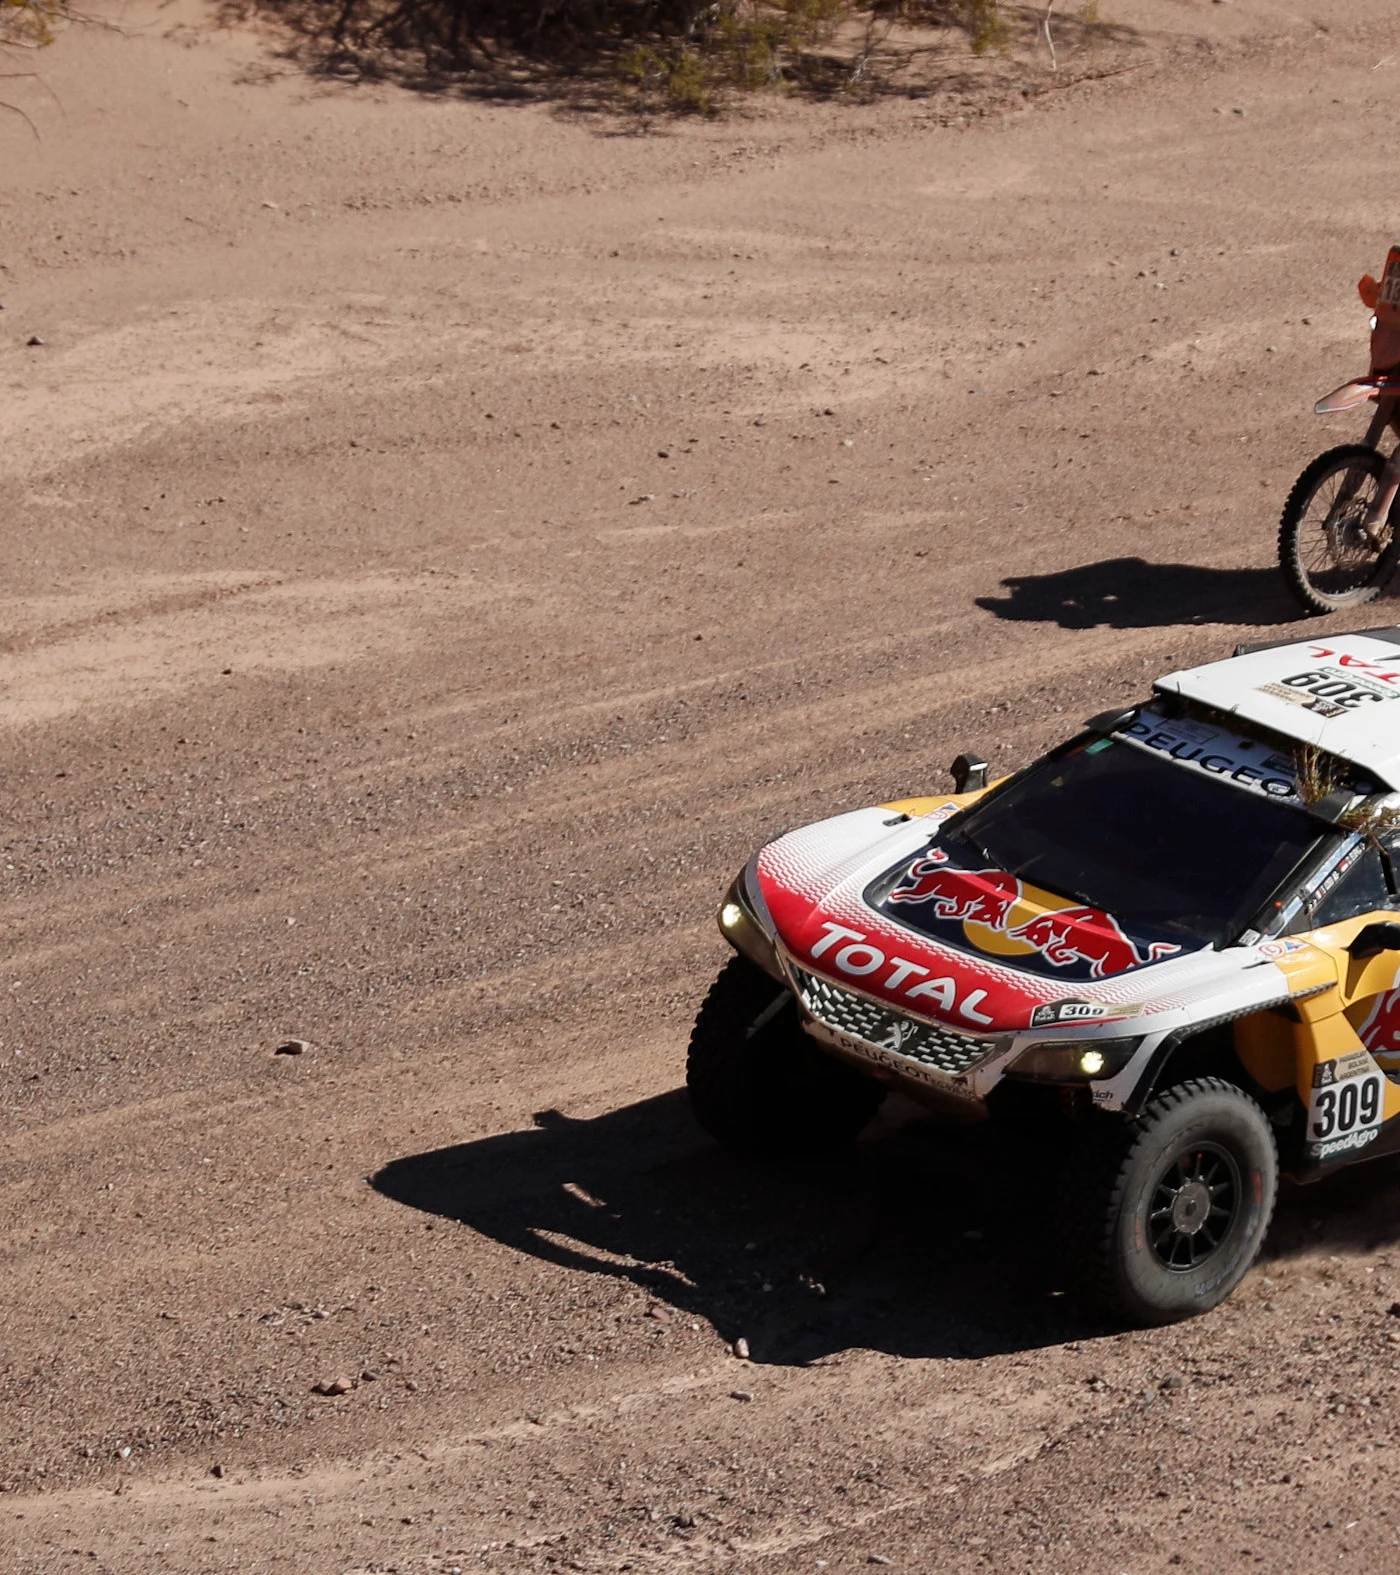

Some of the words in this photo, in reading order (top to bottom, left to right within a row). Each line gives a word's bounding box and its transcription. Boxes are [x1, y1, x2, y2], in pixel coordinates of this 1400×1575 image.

[1281, 671, 1384, 708] 309
[1120, 721, 1299, 797] PEUGEO
[810, 920, 994, 1025] TOTAL
[1064, 1005, 1104, 1016] 309
[1314, 1076, 1380, 1139] 309
[1311, 1127, 1378, 1160] SpeedAgro
